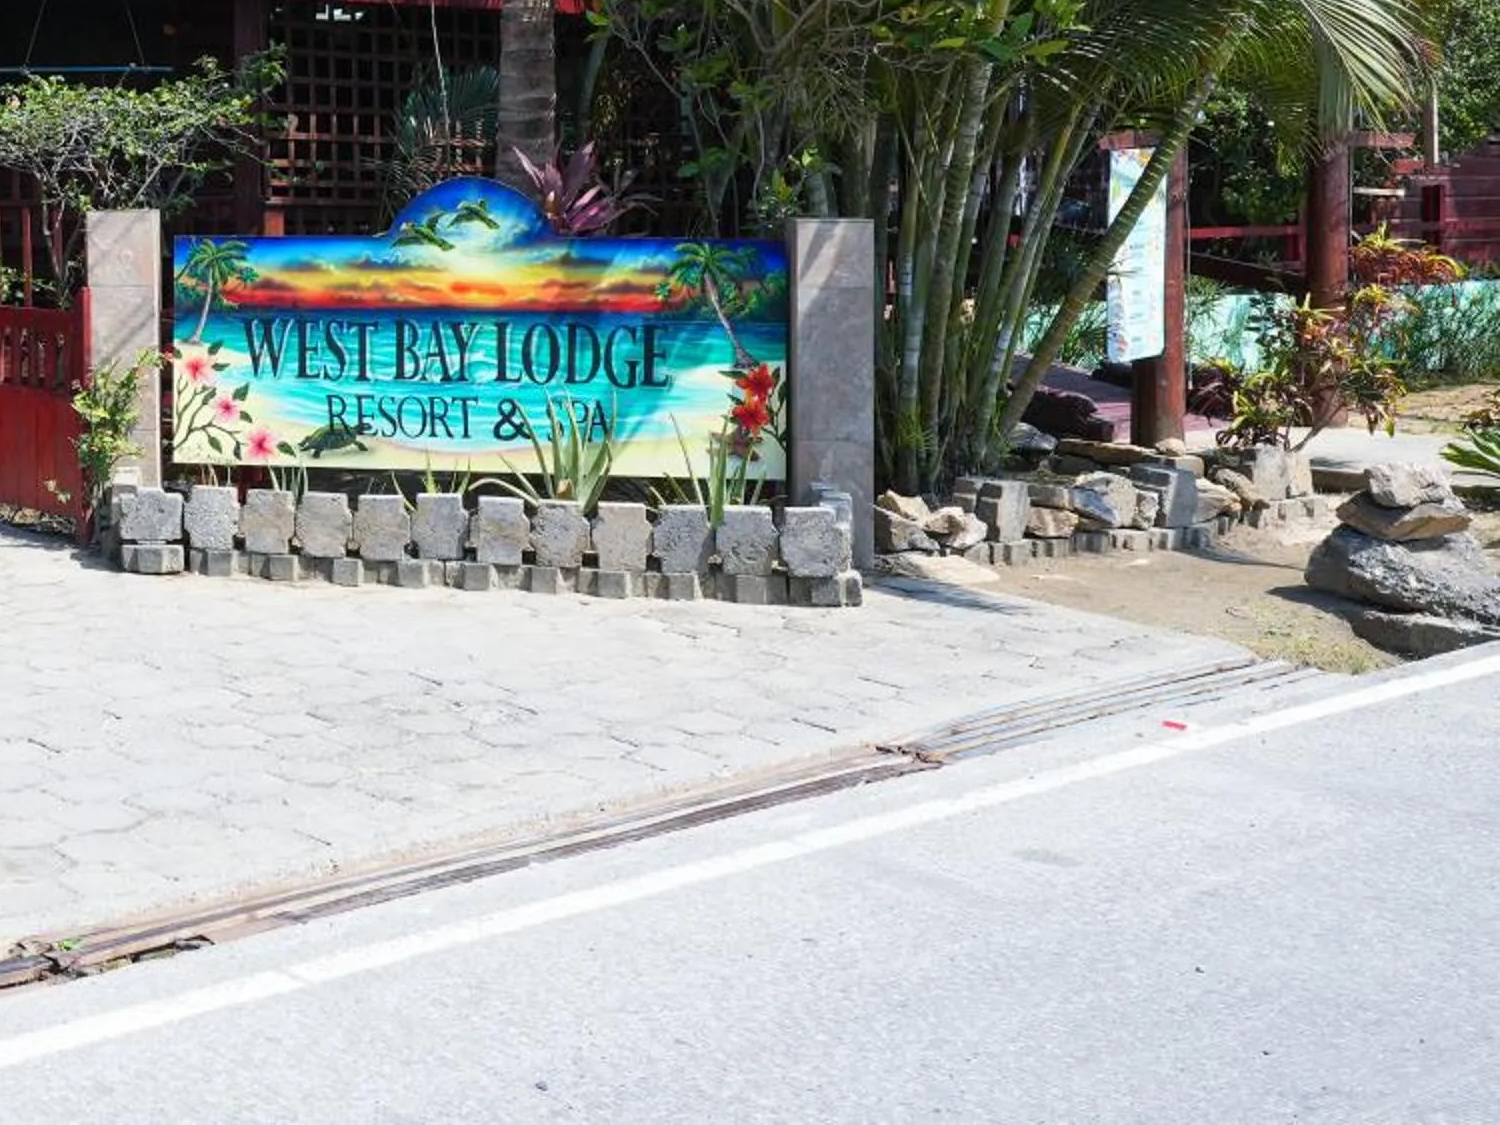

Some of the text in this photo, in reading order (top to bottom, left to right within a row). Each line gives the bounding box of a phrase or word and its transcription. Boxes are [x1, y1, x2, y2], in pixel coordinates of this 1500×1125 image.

[243, 317, 670, 389] WEST BAY LODGE
[326, 393, 479, 440] RESORT
[493, 398, 533, 441] &
